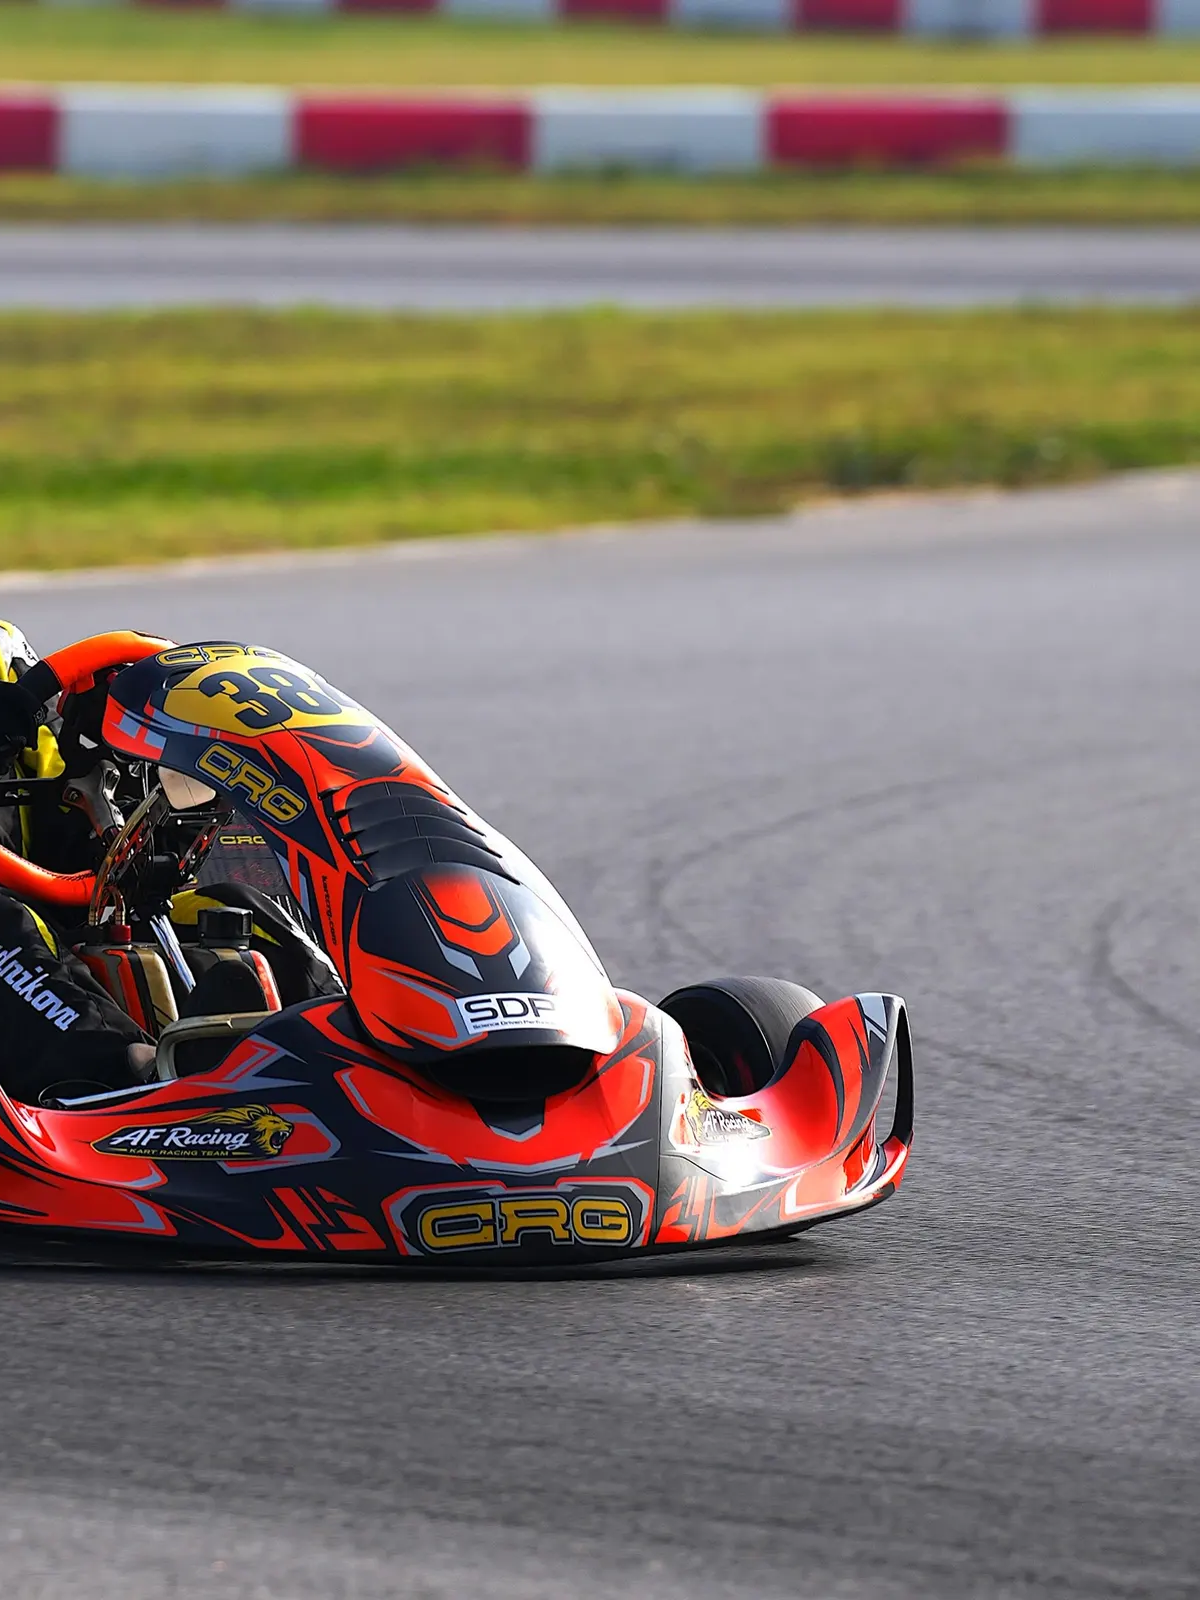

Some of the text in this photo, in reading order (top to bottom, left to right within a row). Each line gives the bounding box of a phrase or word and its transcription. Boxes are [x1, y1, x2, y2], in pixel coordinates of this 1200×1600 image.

[198, 667, 350, 730] 38
[196, 743, 306, 824] CRG
[464, 997, 556, 1023] SDP
[109, 1126, 251, 1150] AF Racing
[420, 1198, 631, 1252] CRG
